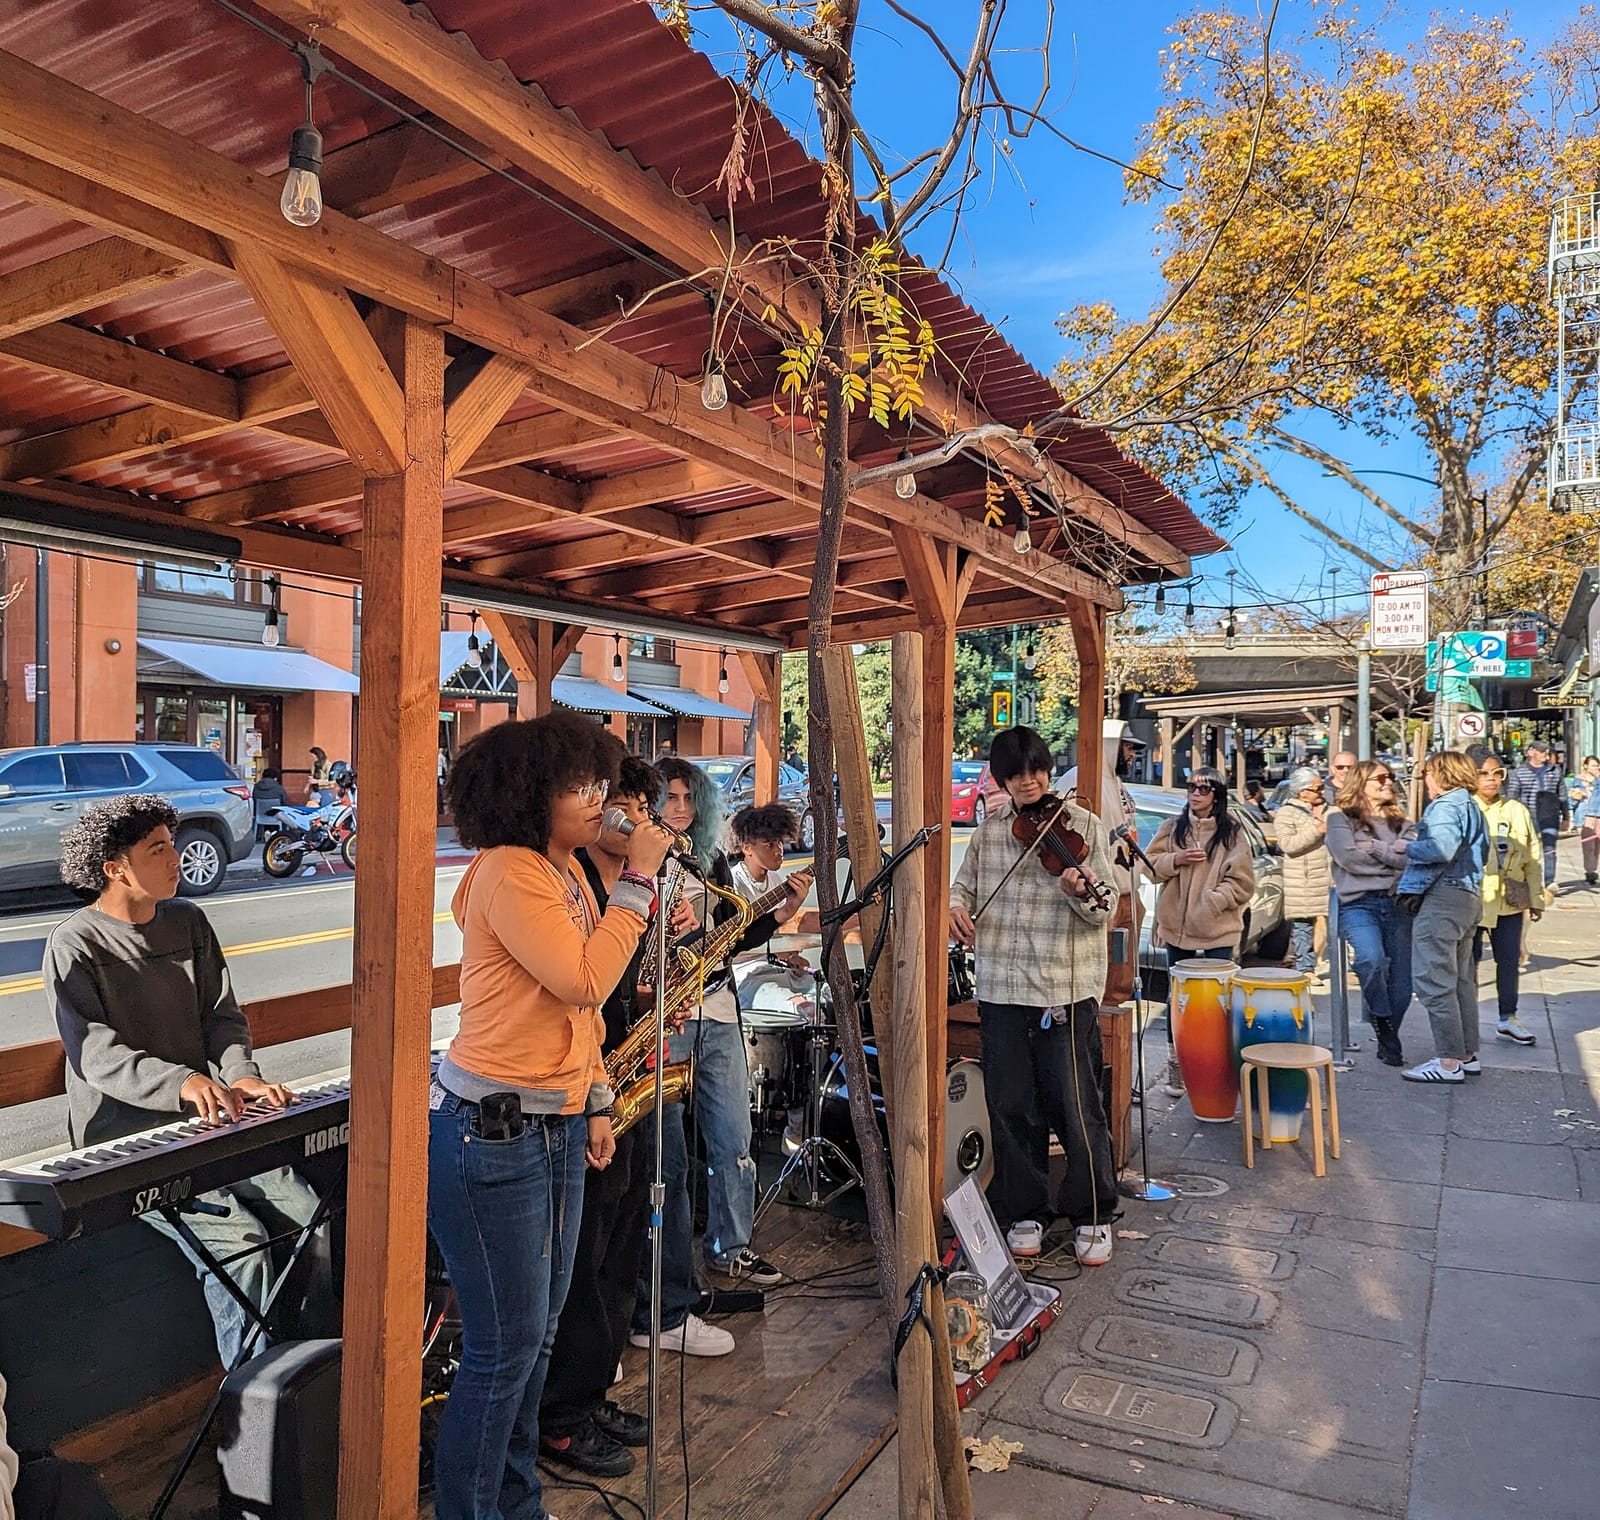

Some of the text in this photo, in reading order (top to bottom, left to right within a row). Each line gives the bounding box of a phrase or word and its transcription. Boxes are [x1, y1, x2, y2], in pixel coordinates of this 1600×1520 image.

[1374, 578, 1424, 592] NO PARKING
[1377, 601, 1422, 611] 12:00 AM TO
[1384, 613, 1414, 622] 3:00 AM
[1376, 624, 1423, 634] MON WED FRI
[1482, 664, 1502, 673] HERE
[304, 1122, 350, 1157] KORG
[131, 1175, 192, 1217] SP-100
